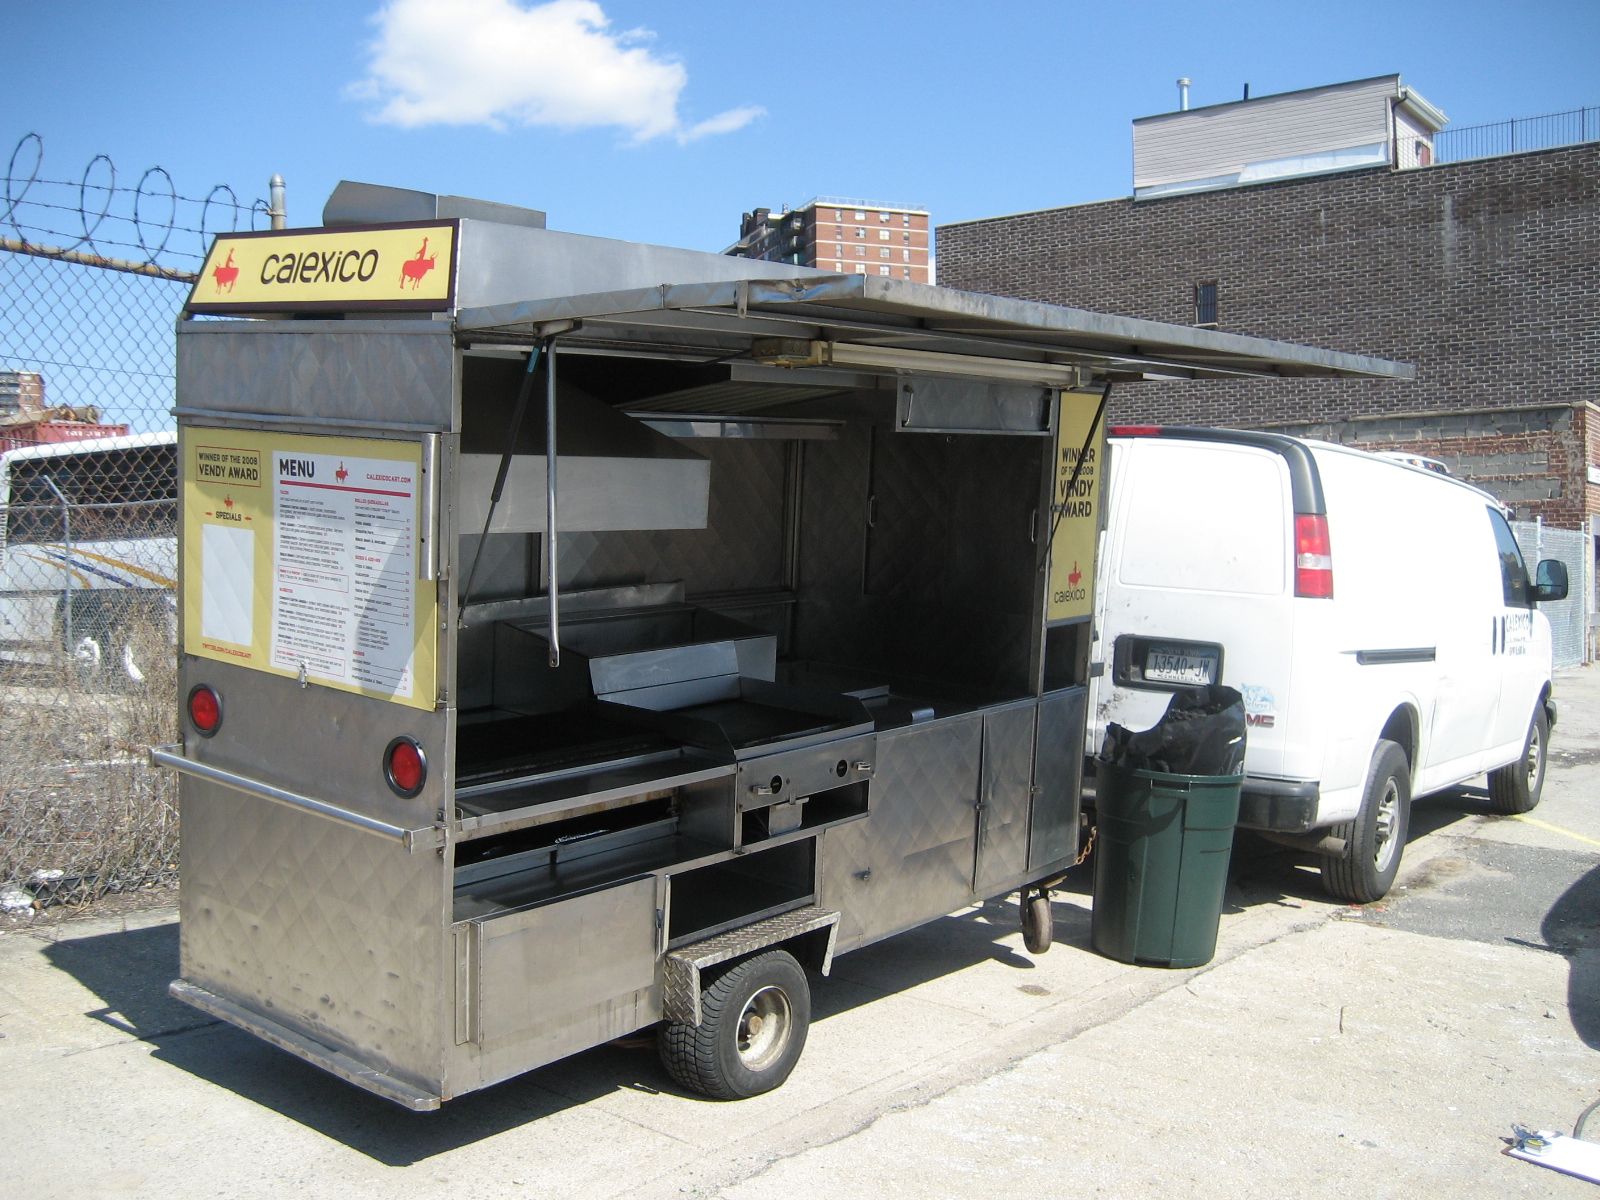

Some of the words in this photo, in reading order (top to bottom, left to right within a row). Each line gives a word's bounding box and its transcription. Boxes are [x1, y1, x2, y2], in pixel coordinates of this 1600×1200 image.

[198, 452, 220, 462] WINNER
[230, 455, 241, 464] THE
[242, 456, 258, 466] 2008
[199, 463, 226, 478] VENDY
[228, 466, 259, 481] AWARD
[279, 458, 315, 479] MENU
[215, 511, 242, 522] SPECIALS
[1060, 501, 1092, 518] AWARD
[1246, 713, 1275, 728] MC
